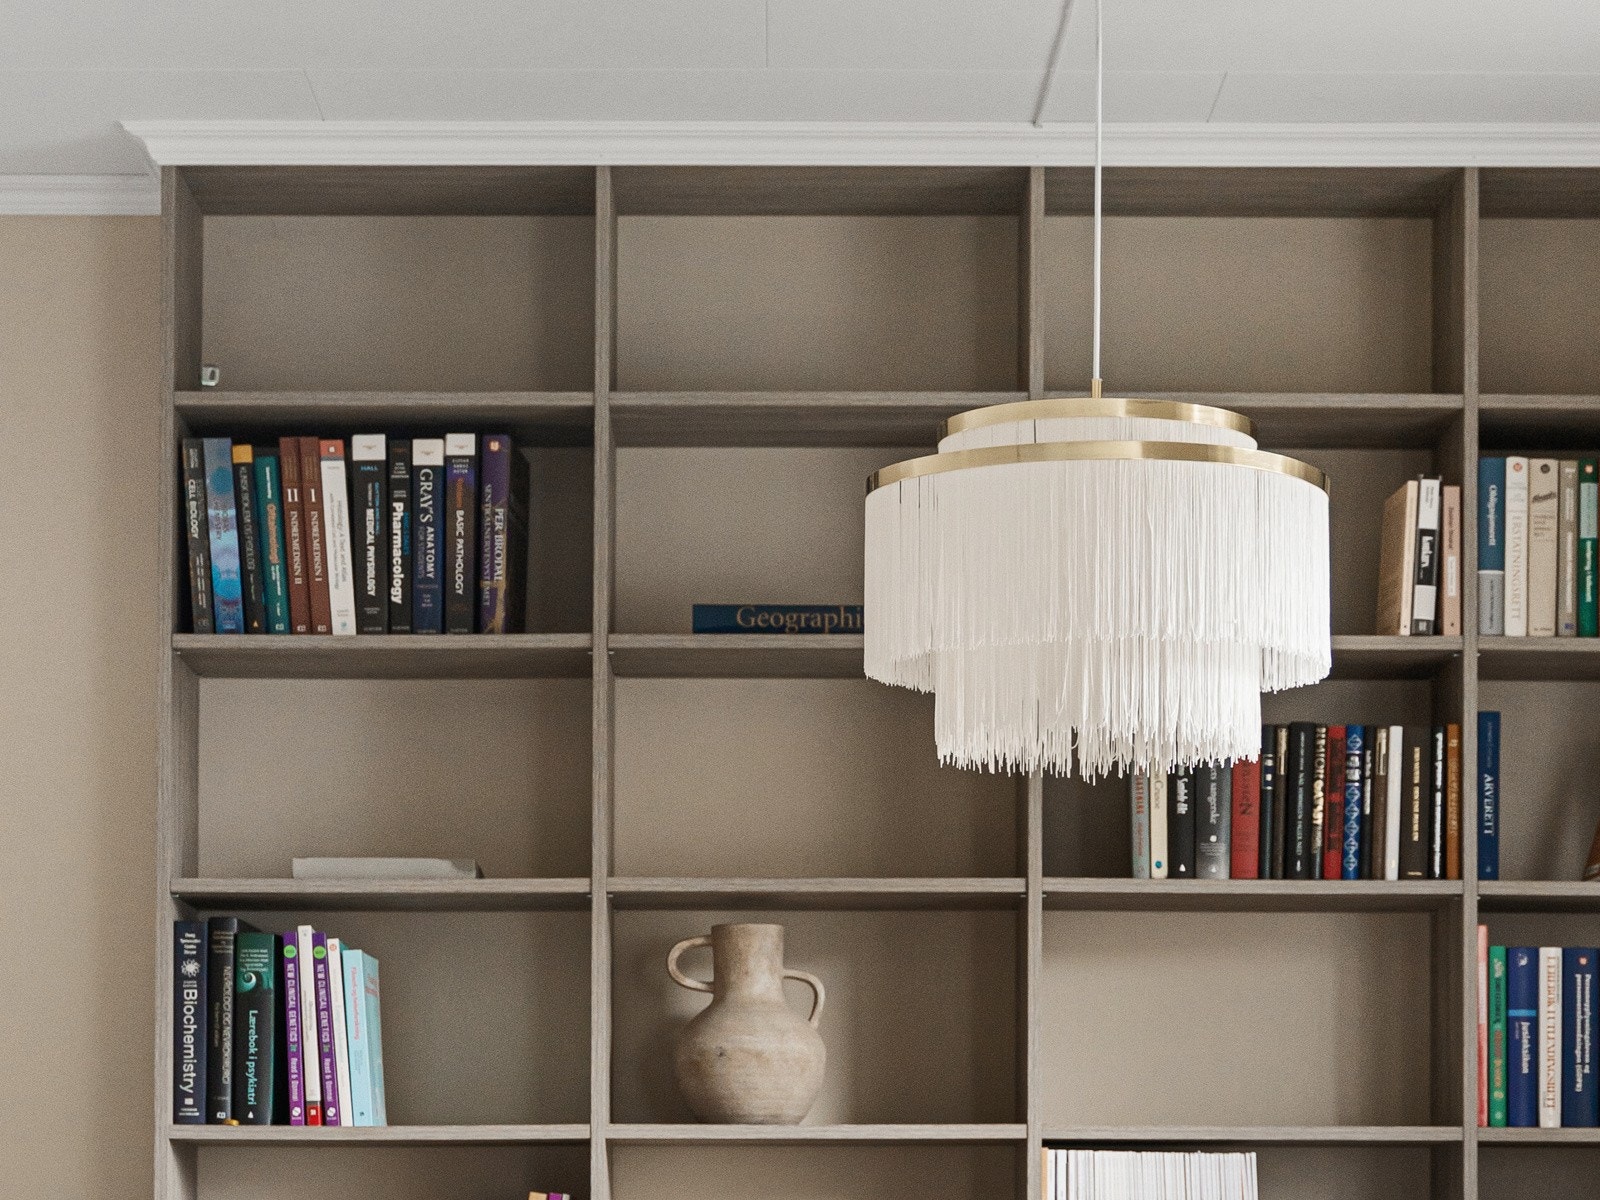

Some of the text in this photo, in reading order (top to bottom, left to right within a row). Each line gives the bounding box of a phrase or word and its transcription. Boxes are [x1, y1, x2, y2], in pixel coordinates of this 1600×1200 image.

[188, 479, 196, 499] CELL
[287, 488, 299, 503] II
[419, 468, 434, 523] GRAY'S
[189, 500, 199, 539] BIOLOGY
[366, 508, 375, 545] MEDICAL
[391, 502, 405, 604] Pharmacology
[426, 526, 435, 579] ANATOMY
[455, 510, 464, 595] BASIC PATHOLOGY
[494, 508, 504, 581] PER BRODAL
[367, 545, 376, 596] PHYSIOLOGY
[287, 963, 296, 978] NEW
[316, 963, 325, 979] NEW
[179, 988, 198, 1093] Biochemistry
[249, 1010, 258, 1054] Lærebok
[288, 1010, 298, 1042] GENETICS
[320, 1011, 330, 1043] GENETICS
[246, 1061, 258, 1105] psykiatri
